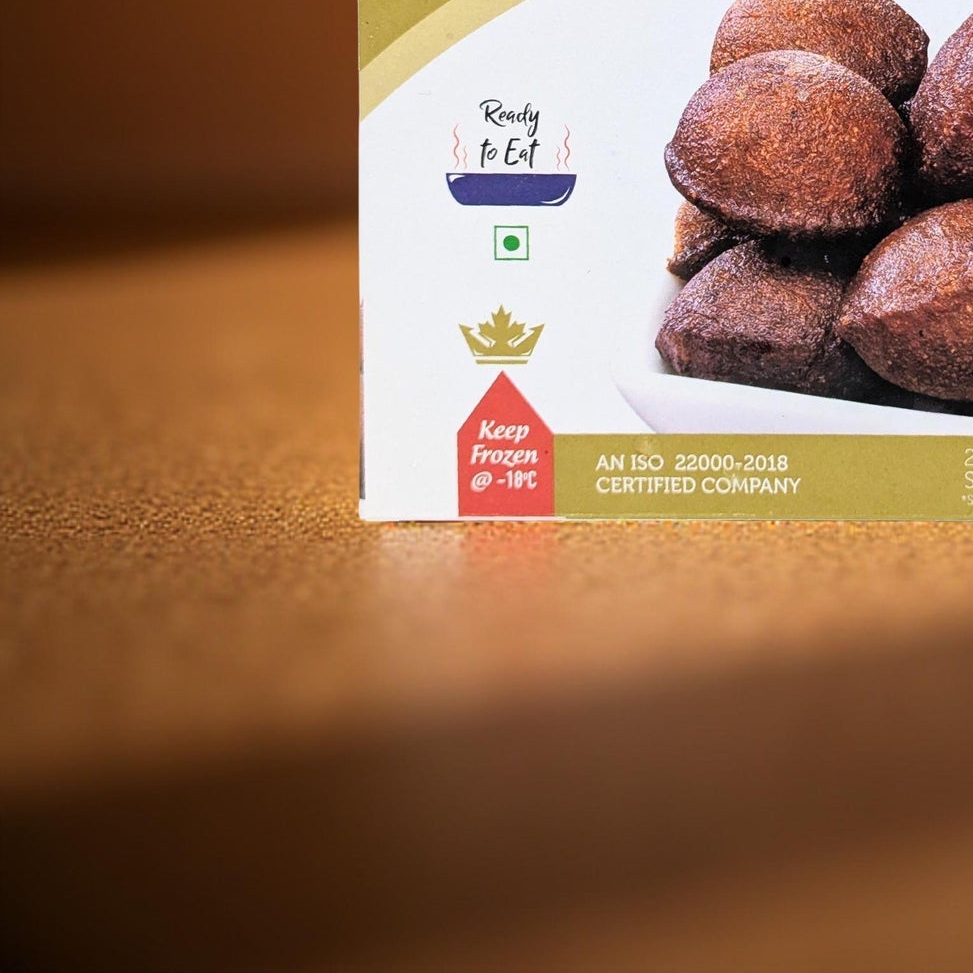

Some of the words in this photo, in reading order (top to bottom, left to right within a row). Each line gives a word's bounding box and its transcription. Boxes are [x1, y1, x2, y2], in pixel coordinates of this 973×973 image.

[479, 99, 540, 138] Ready
[480, 138, 498, 168] to
[504, 138, 540, 169] Eat
[478, 419, 530, 444] Keep
[470, 444, 539, 467] Frozen
[595, 454, 625, 472] AN
[630, 454, 665, 472] ISO
[674, 454, 789, 472] 22000-2018
[470, 471, 493, 493] @
[595, 476, 697, 494] CERTIFIED
[700, 476, 802, 494] COMPANY
